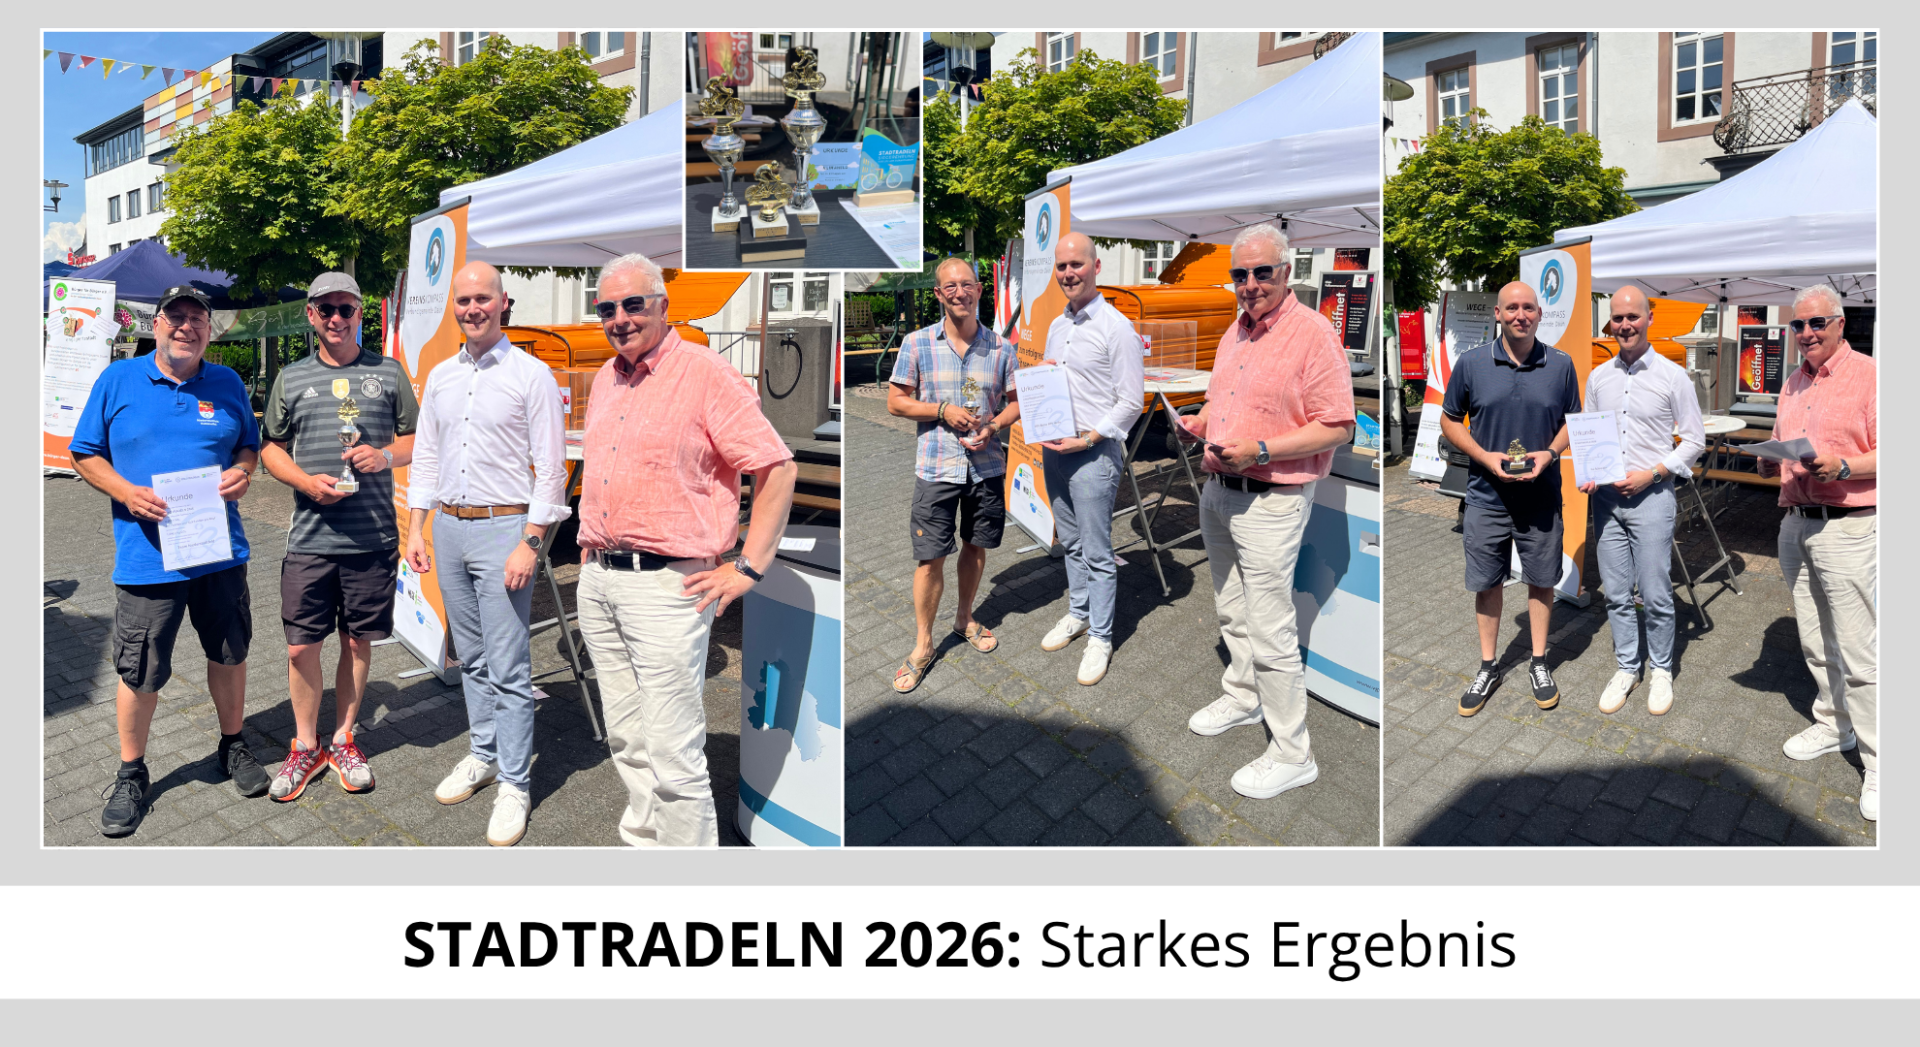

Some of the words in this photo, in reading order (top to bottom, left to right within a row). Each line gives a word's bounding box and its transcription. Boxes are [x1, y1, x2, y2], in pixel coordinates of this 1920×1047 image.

[1332, 292, 1346, 336] eöffnet
[1466, 303, 1486, 311] WEGE
[1542, 310, 1565, 319] KOMPASS
[1751, 344, 1763, 390] Geöffnet
